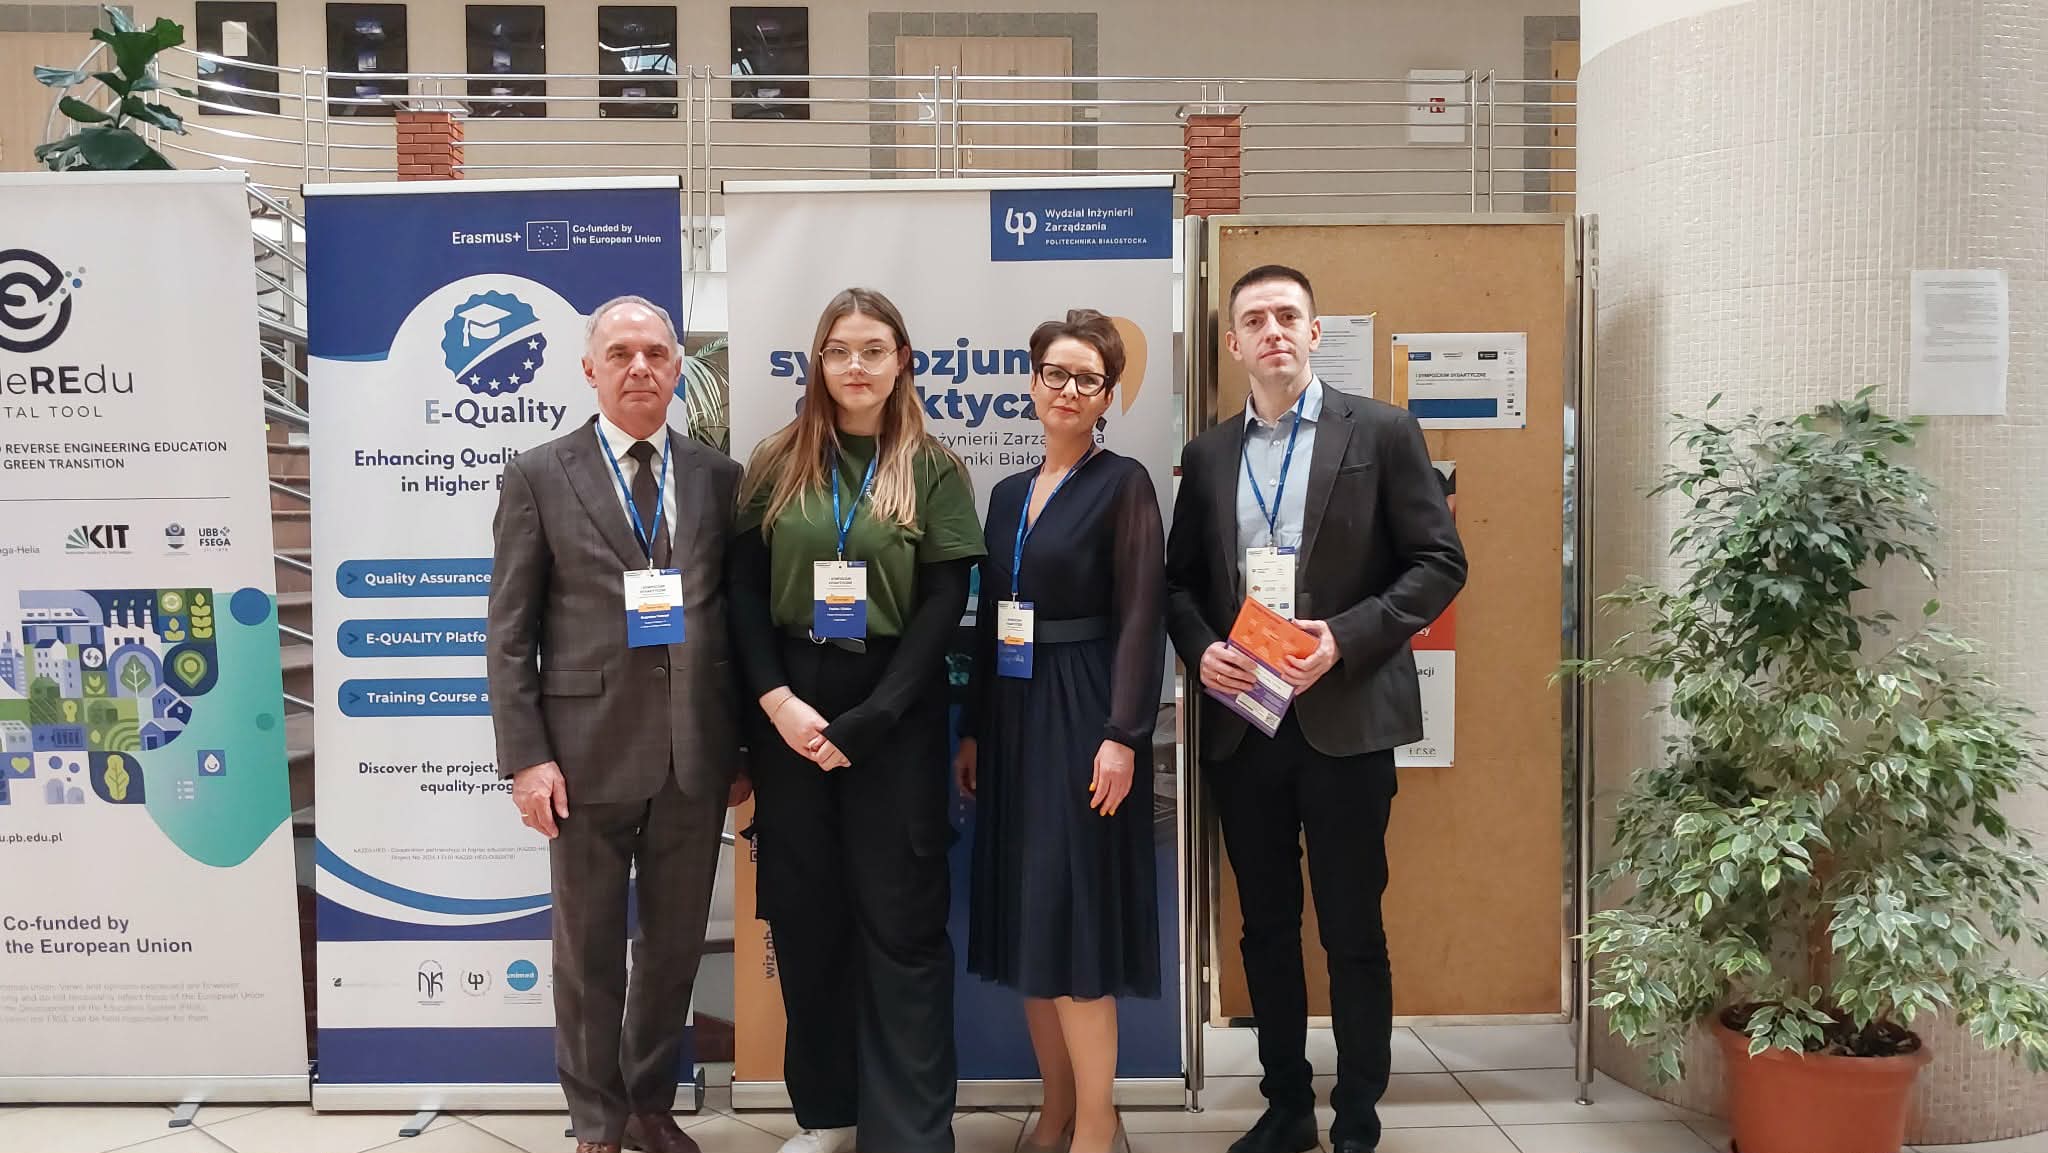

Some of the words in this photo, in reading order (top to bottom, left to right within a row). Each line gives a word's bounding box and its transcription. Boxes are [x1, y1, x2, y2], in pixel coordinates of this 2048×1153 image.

[1088, 207, 1133, 219] Inżynierii
[572, 224, 619, 233] Co-funded
[621, 224, 633, 235] by
[1045, 221, 1107, 234] Zarządzania
[452, 231, 521, 245] Erasmus+
[572, 236, 586, 244] the
[589, 235, 633, 246] European
[635, 234, 661, 243] Union
[1045, 238, 1096, 246] POLITECHNIKA
[3, 406, 40, 419] TAL
[48, 405, 104, 419] TOOL
[424, 396, 567, 431] E-Quality
[5, 443, 61, 455] REVERSE
[64, 442, 151, 454] ENGINEERING
[154, 440, 228, 453] EDUCATION
[3, 459, 46, 471] GREEN
[49, 458, 125, 470] TRANSITION
[354, 449, 455, 470] Enhancing
[461, 447, 519, 468] Quali
[401, 476, 419, 493] in
[425, 474, 490, 497] Higher
[82, 524, 130, 549] KIT
[198, 527, 219, 537] UBB
[199, 537, 232, 547] FSEGA
[365, 571, 416, 587] Quality
[420, 571, 492, 585] Assurance
[366, 630, 442, 646] E-QUALITY
[446, 630, 488, 644] Platfo
[367, 690, 426, 706] Training
[429, 690, 478, 704] Course
[358, 761, 417, 775] Discover
[421, 761, 443, 774] the
[446, 761, 499, 777] project,
[420, 779, 514, 796] equality-prog
[0, 831, 64, 846] u.pb.edu.pl
[3, 914, 101, 931] Co-funded
[107, 914, 129, 934] by
[5, 938, 34, 954] the
[40, 938, 131, 956] European
[136, 937, 193, 953] Union
